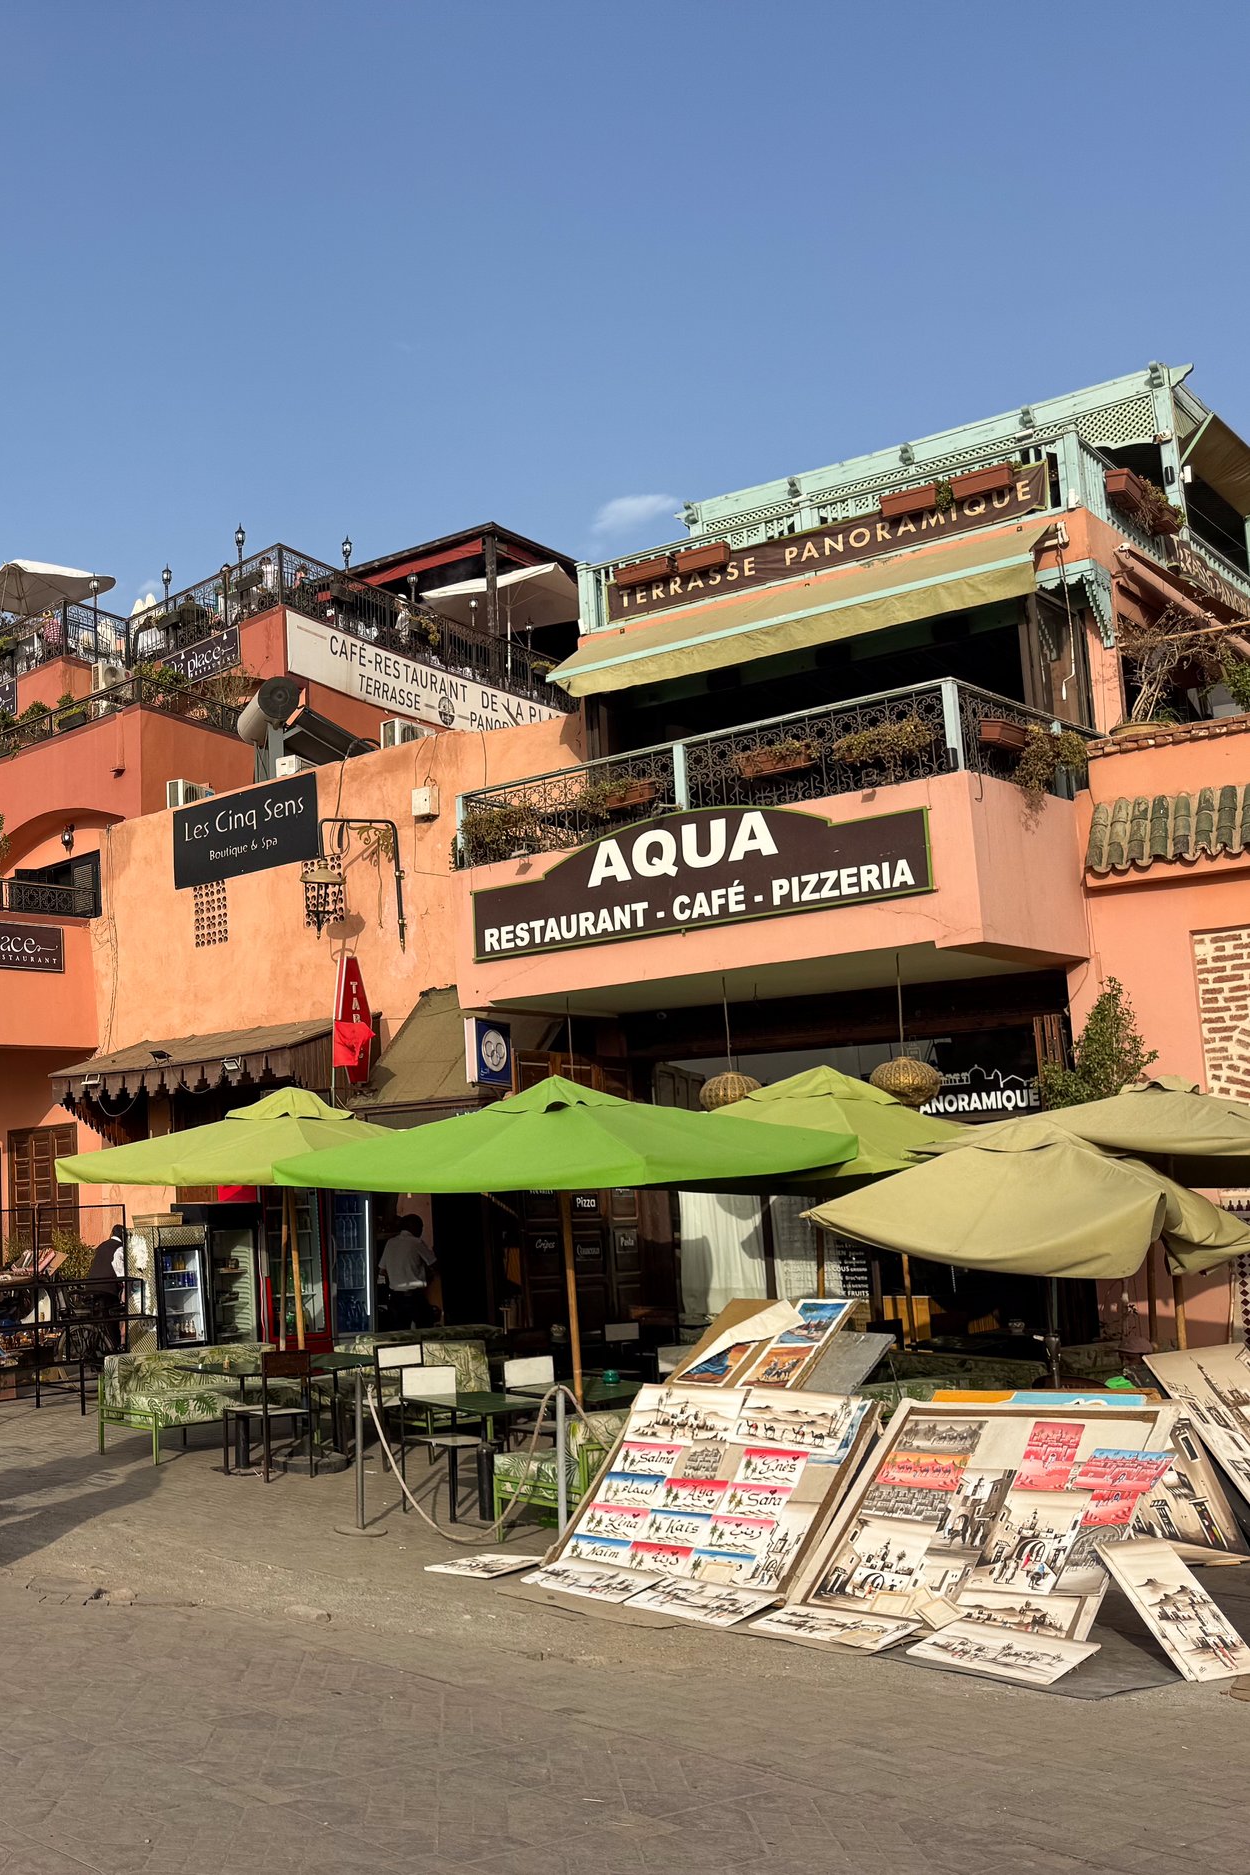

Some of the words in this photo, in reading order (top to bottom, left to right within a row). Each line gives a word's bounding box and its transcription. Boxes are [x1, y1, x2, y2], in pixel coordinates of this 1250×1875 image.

[620, 556, 756, 608] TERRASSE
[783, 479, 1033, 567] PANORAMIQUE
[187, 646, 236, 679] place
[329, 634, 468, 703] CAFÉ-RESTAURANT
[481, 690, 499, 713] DE
[358, 672, 421, 711] TERRASSE
[184, 821, 210, 842] Les
[215, 809, 258, 833] Cinq
[264, 796, 304, 822] Sens
[209, 843, 249, 861] Boutique
[250, 838, 258, 850] &
[261, 836, 278, 851] Spa
[587, 810, 779, 889] AQUA
[483, 901, 649, 952] RESTAURANT
[672, 879, 746, 921] CAFÉ
[771, 858, 916, 906] PIZZERIA
[575, 1195, 596, 1208] Pizza
[639, 1450, 675, 1465] Salma
[746, 1492, 783, 1507] Sara
[605, 1513, 639, 1530] Lina
